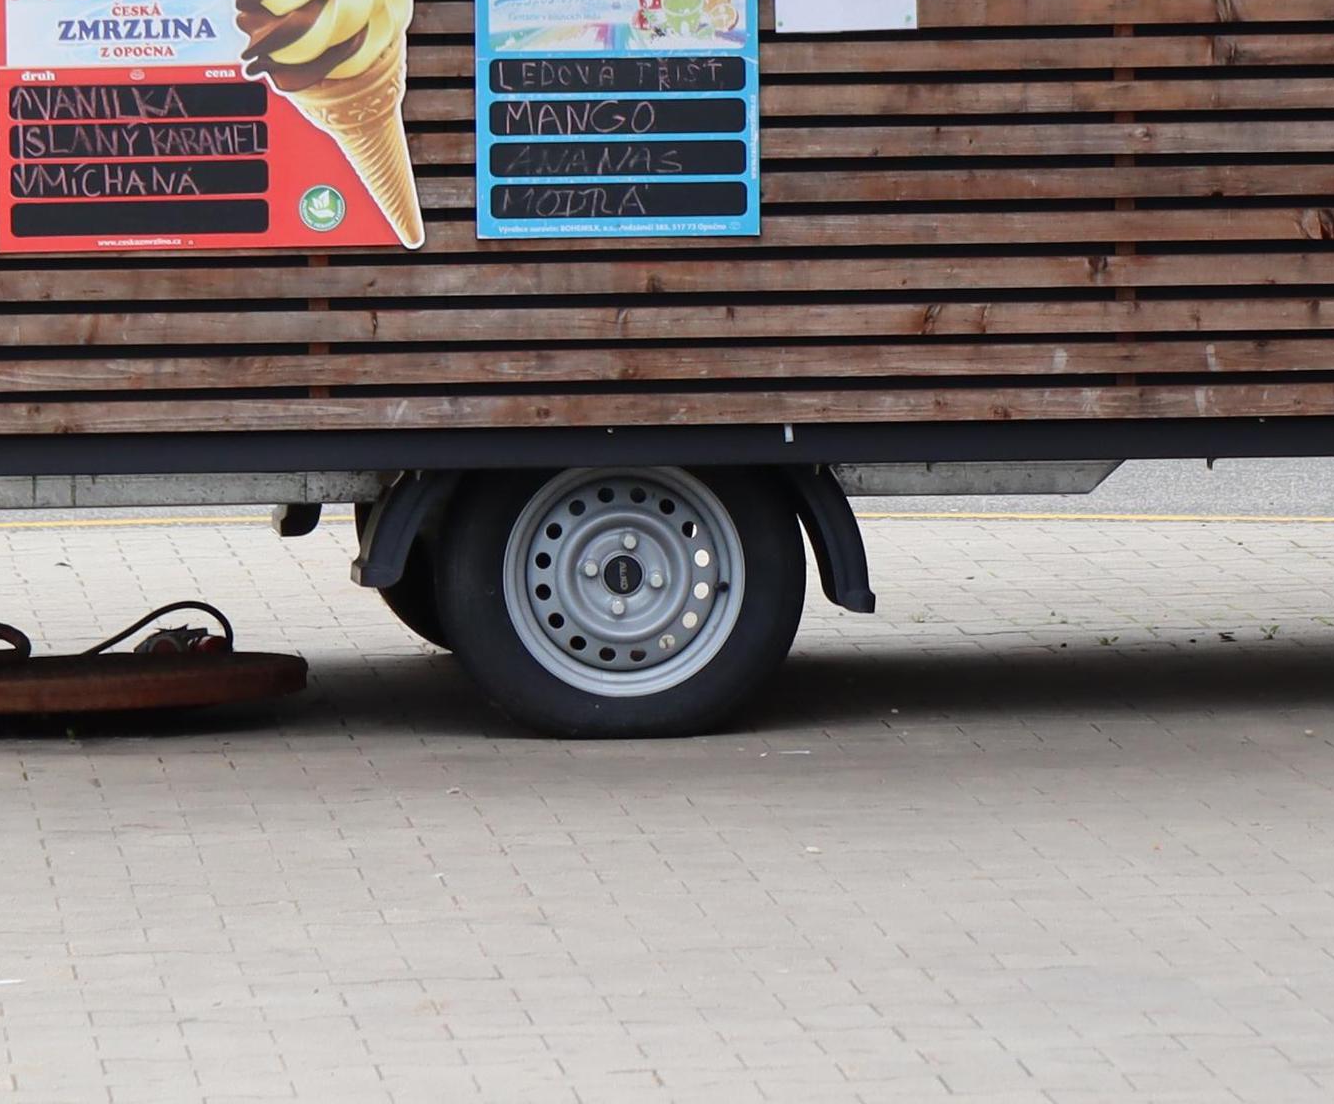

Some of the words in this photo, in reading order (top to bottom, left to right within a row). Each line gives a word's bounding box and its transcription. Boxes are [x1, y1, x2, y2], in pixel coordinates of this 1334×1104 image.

[111, 2, 162, 17] ČESKÁ
[58, 18, 217, 41] ZMRZLINA
[100, 46, 110, 57] Z
[113, 43, 174, 57] OPOČNA
[21, 70, 56, 82] druh
[205, 69, 236, 78] cena
[506, 100, 656, 135] MANGO
[149, 123, 269, 157] KARAMEL
[507, 146, 682, 175] ANANAS
